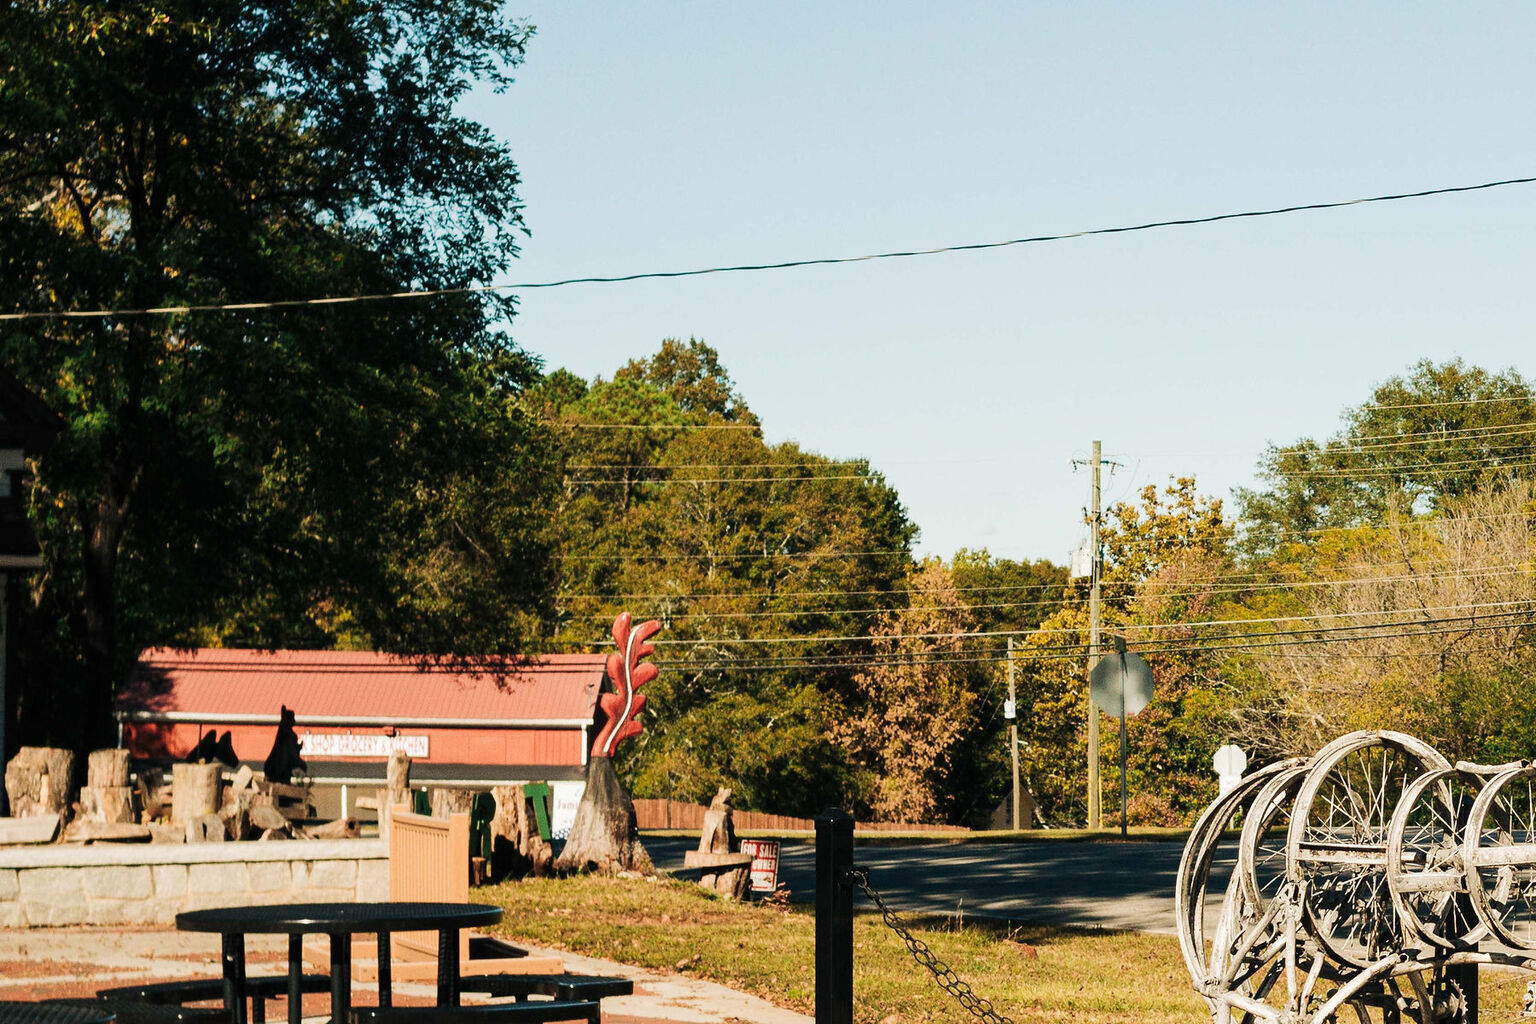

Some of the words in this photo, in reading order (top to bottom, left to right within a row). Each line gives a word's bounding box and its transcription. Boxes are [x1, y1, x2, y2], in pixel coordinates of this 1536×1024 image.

[743, 843, 757, 856] FOR
[759, 844, 777, 858] SALE
[752, 859, 776, 870] OWNER
